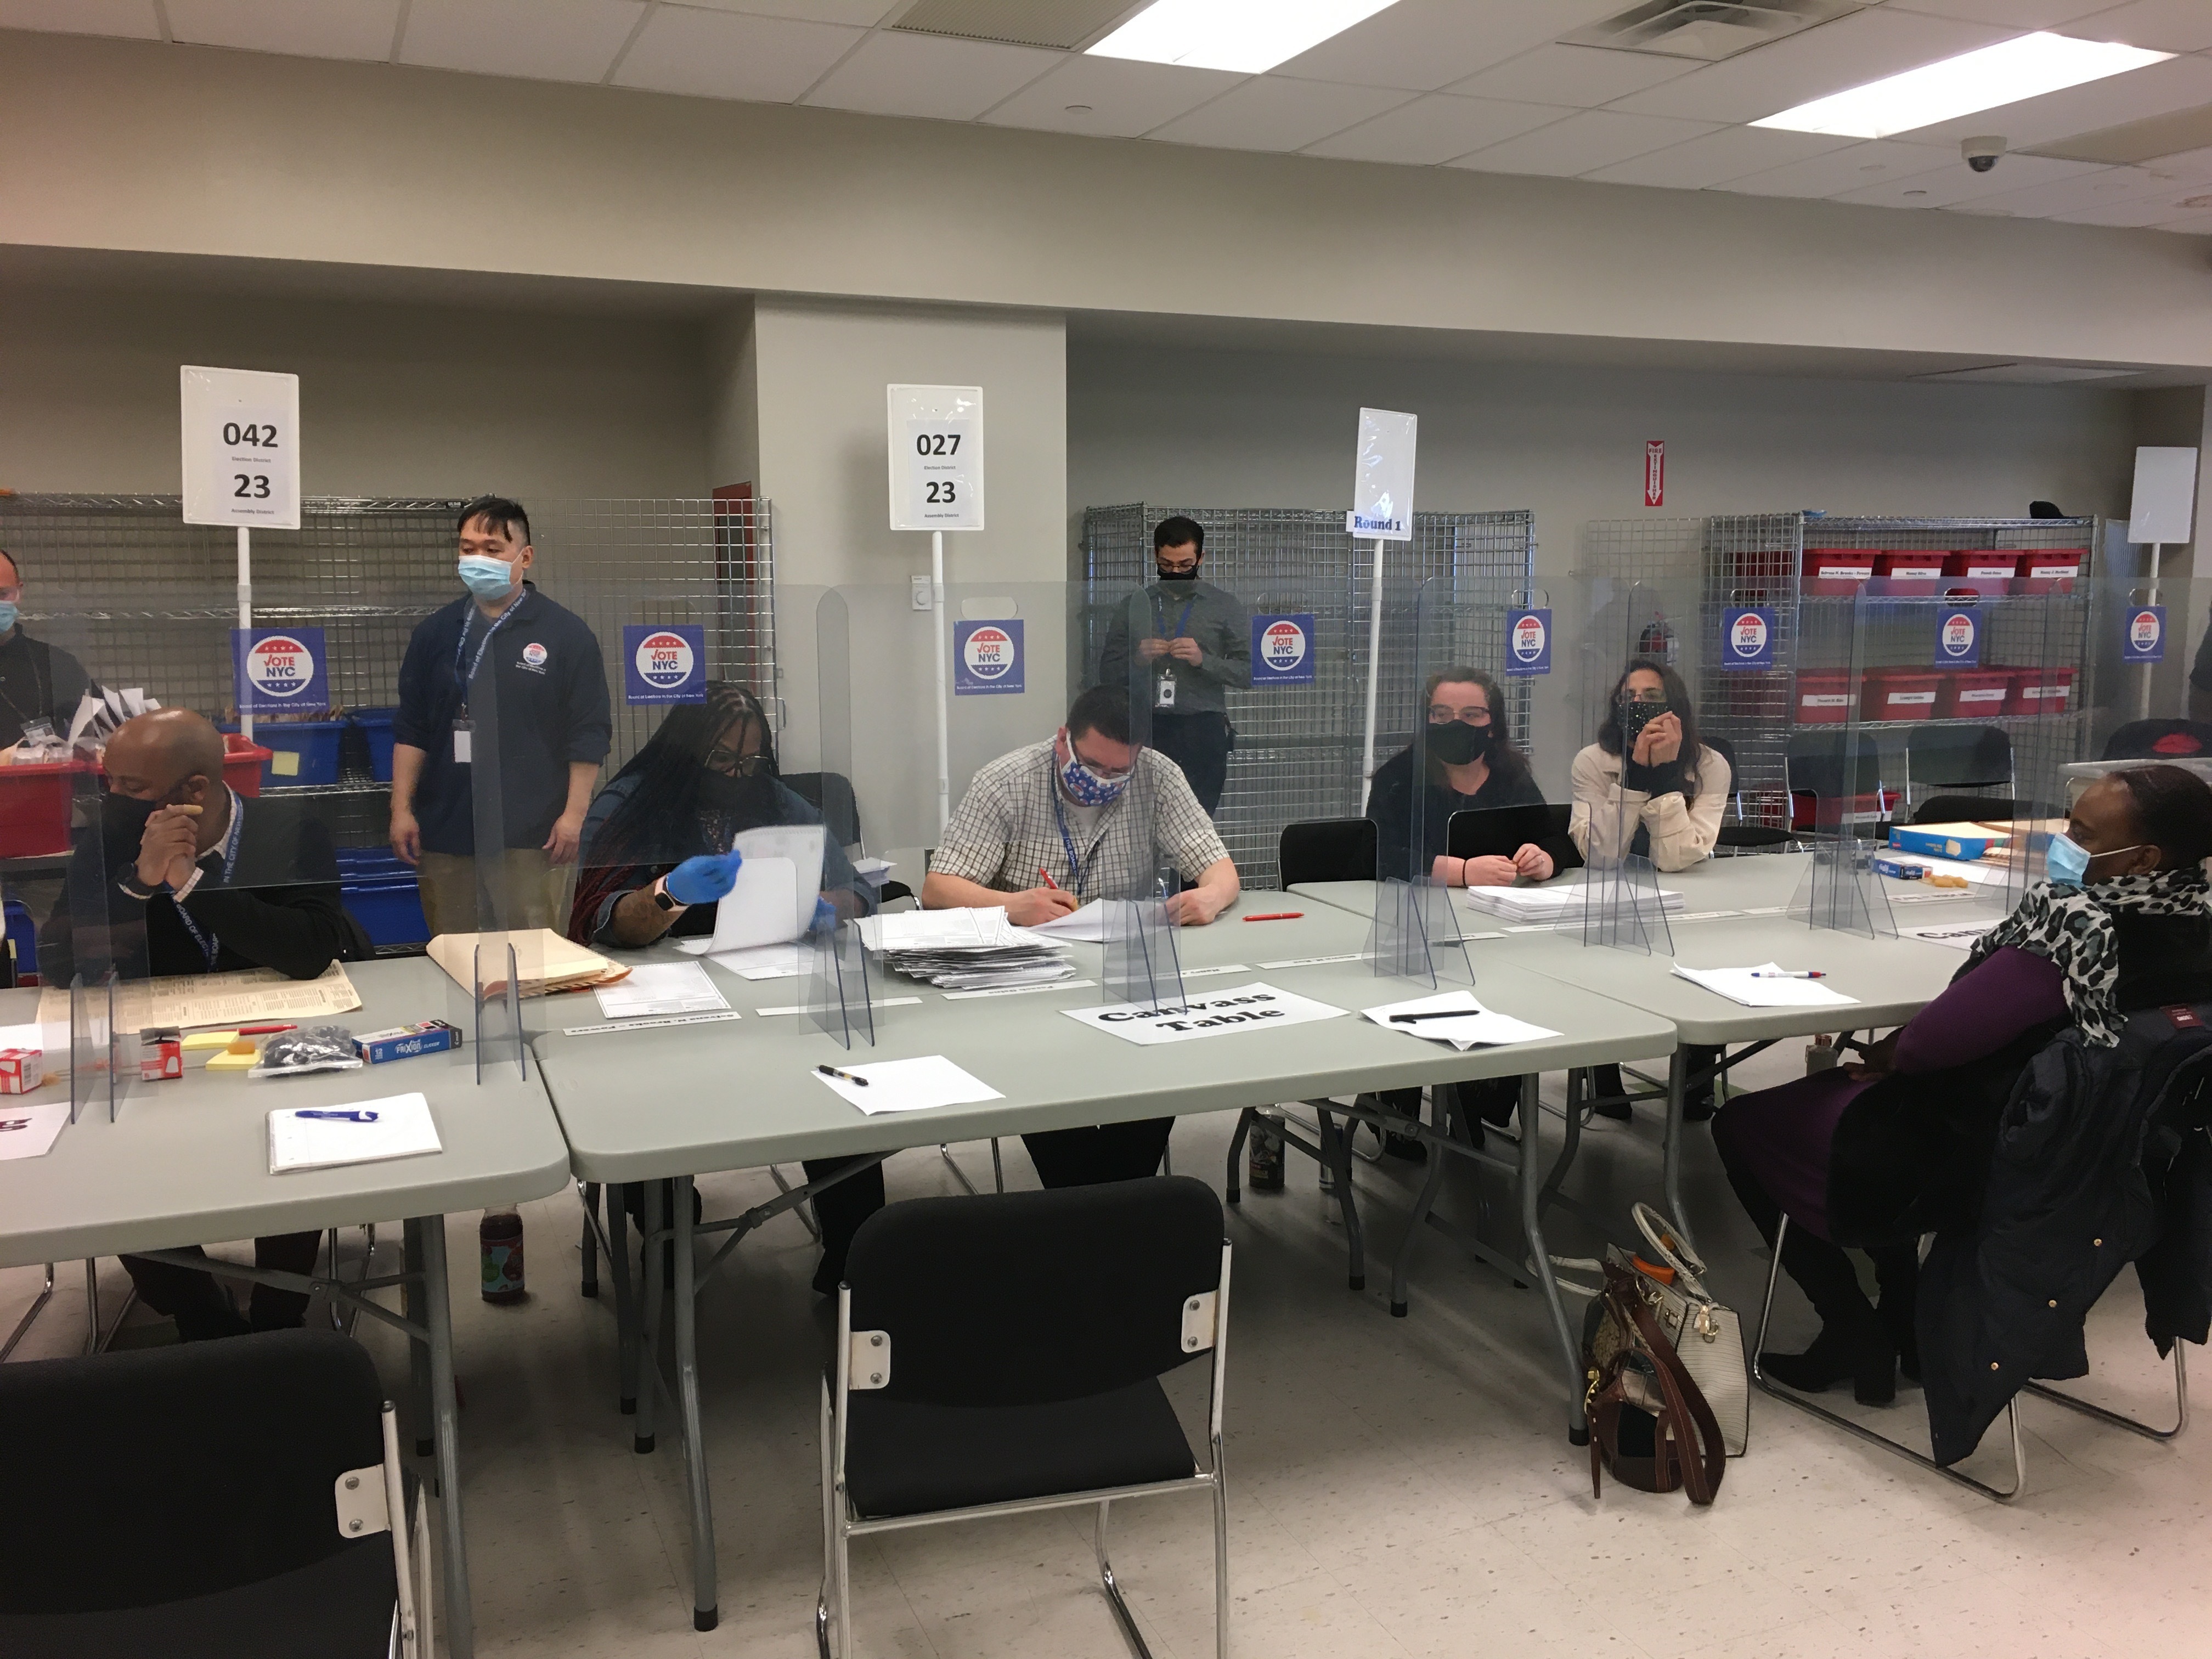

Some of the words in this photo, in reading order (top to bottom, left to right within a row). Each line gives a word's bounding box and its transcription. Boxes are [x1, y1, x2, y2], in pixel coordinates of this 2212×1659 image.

[223, 422, 278, 448] 042
[916, 434, 961, 455] 027
[234, 474, 271, 498] 23
[926, 481, 956, 503] 23
[1354, 516, 1392, 531] Round
[1395, 521, 1401, 531] 1
[500, 611, 511, 620] City
[1521, 630, 1536, 639] VOTE
[1740, 627, 1757, 635] VOTE
[1951, 627, 1966, 635] VOTE
[1272, 636, 1293, 646] VOTE
[1521, 639, 1536, 647] NYC
[977, 642, 1000, 653] VOTE
[1273, 646, 1294, 654] NYC
[651, 649, 678, 661] VOTE
[978, 653, 1001, 662] NYC
[263, 654, 295, 667] VOTE
[652, 661, 678, 670] NYC
[266, 667, 296, 677] NYC
[232, 837, 239, 845] OF
[228, 846, 237, 860] CITY
[225, 862, 234, 874] THE
[189, 926, 199, 934] OF
[1098, 992, 1277, 1022] Canvass
[1155, 1009, 1285, 1031] Table
